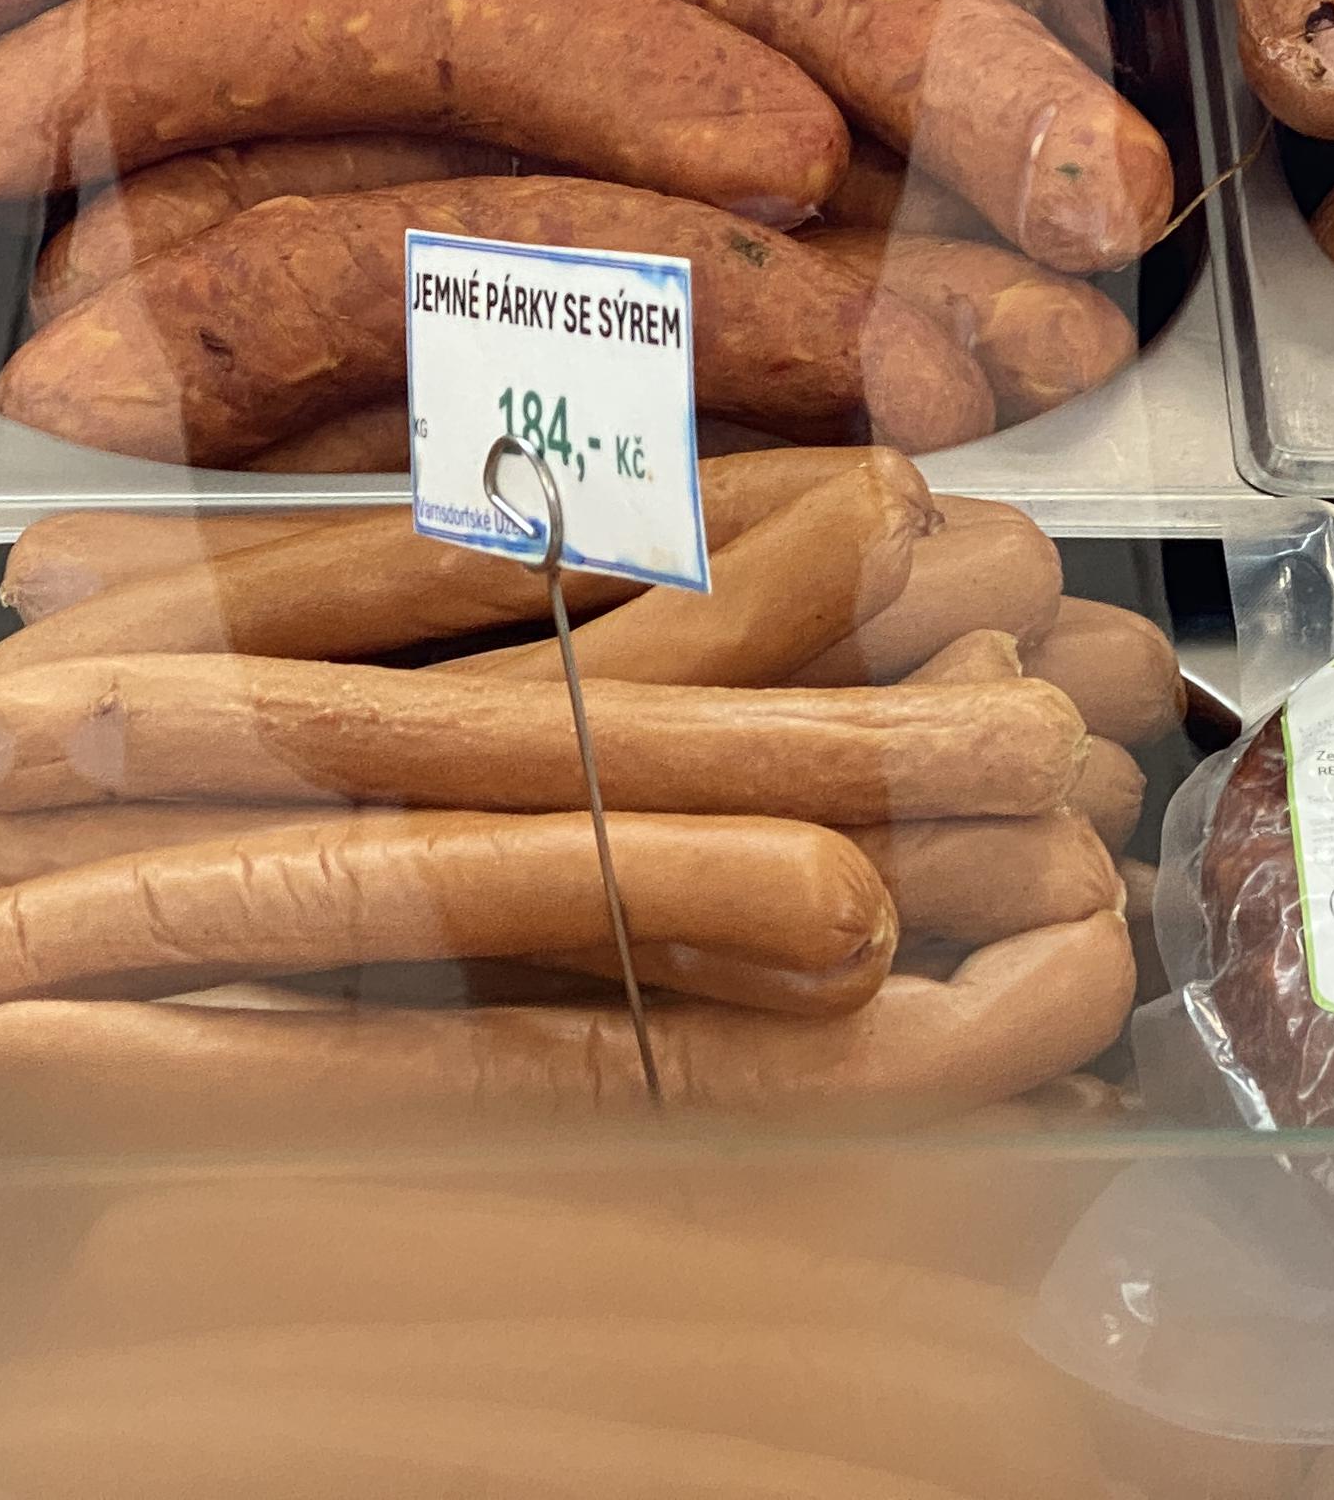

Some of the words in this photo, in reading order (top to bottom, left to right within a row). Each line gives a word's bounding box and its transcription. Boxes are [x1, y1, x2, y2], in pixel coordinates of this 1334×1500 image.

[413, 269, 481, 319] JEMNÉ
[485, 273, 559, 330] PÁRKY
[563, 292, 592, 335] SE
[598, 287, 681, 349] SÝREM
[414, 418, 428, 438] KG
[498, 386, 602, 483] 184,-
[616, 436, 646, 480] Kč
[417, 498, 492, 531] Varnsdorfské
